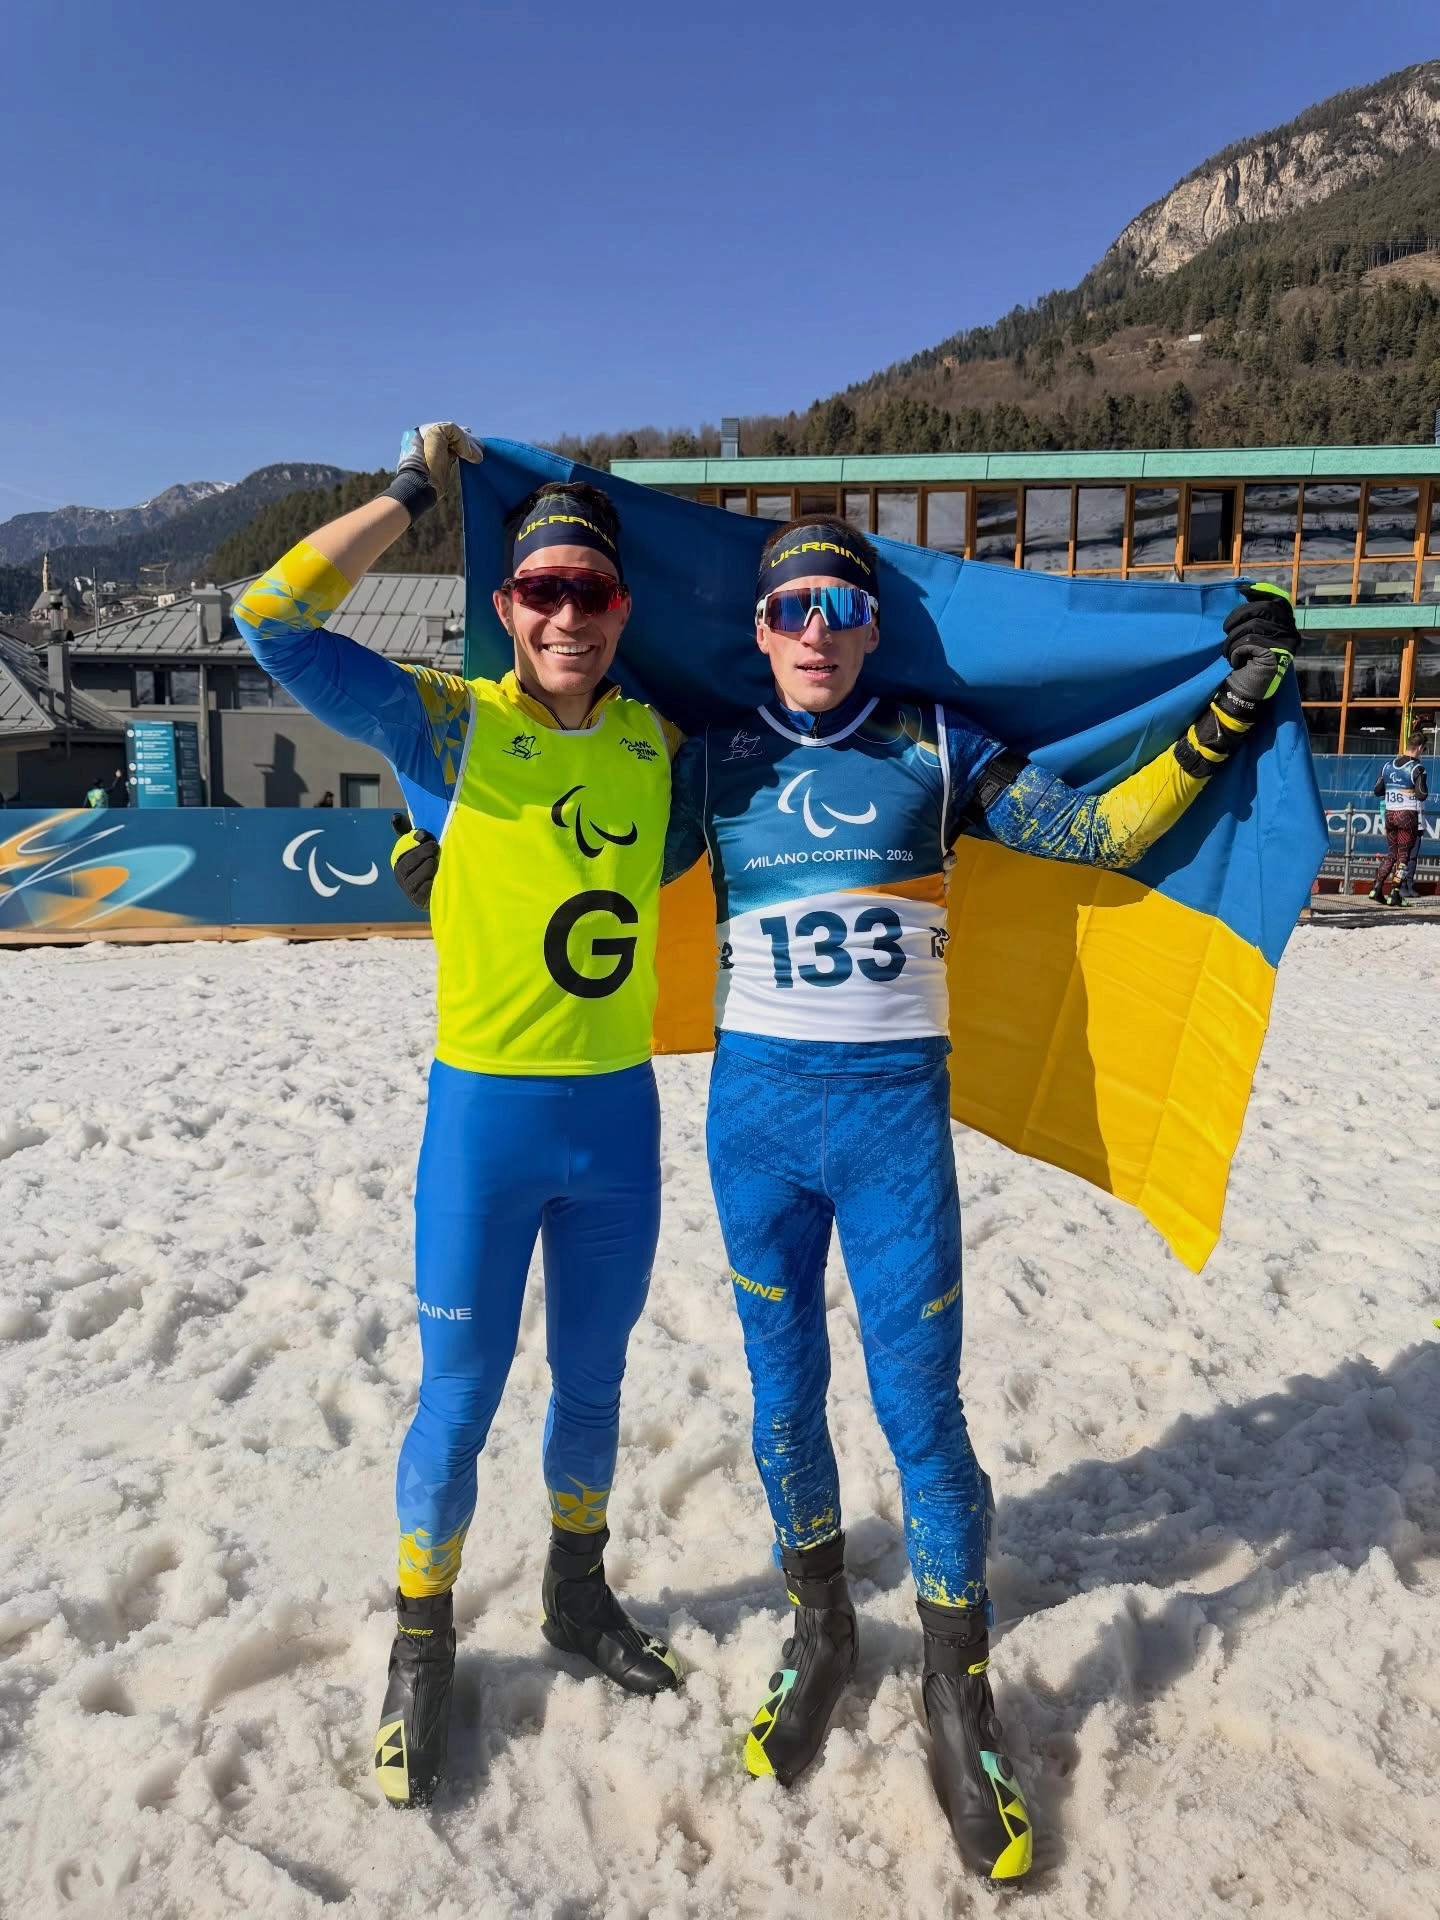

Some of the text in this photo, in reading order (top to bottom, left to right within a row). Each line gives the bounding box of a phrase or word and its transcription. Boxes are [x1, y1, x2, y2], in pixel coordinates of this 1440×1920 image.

[770, 541, 871, 575] UKRAINE
[1386, 791, 1404, 803] 136
[744, 848, 914, 871] MILANO CORTINA 2026
[544, 889, 639, 999] G
[759, 907, 907, 989] 133
